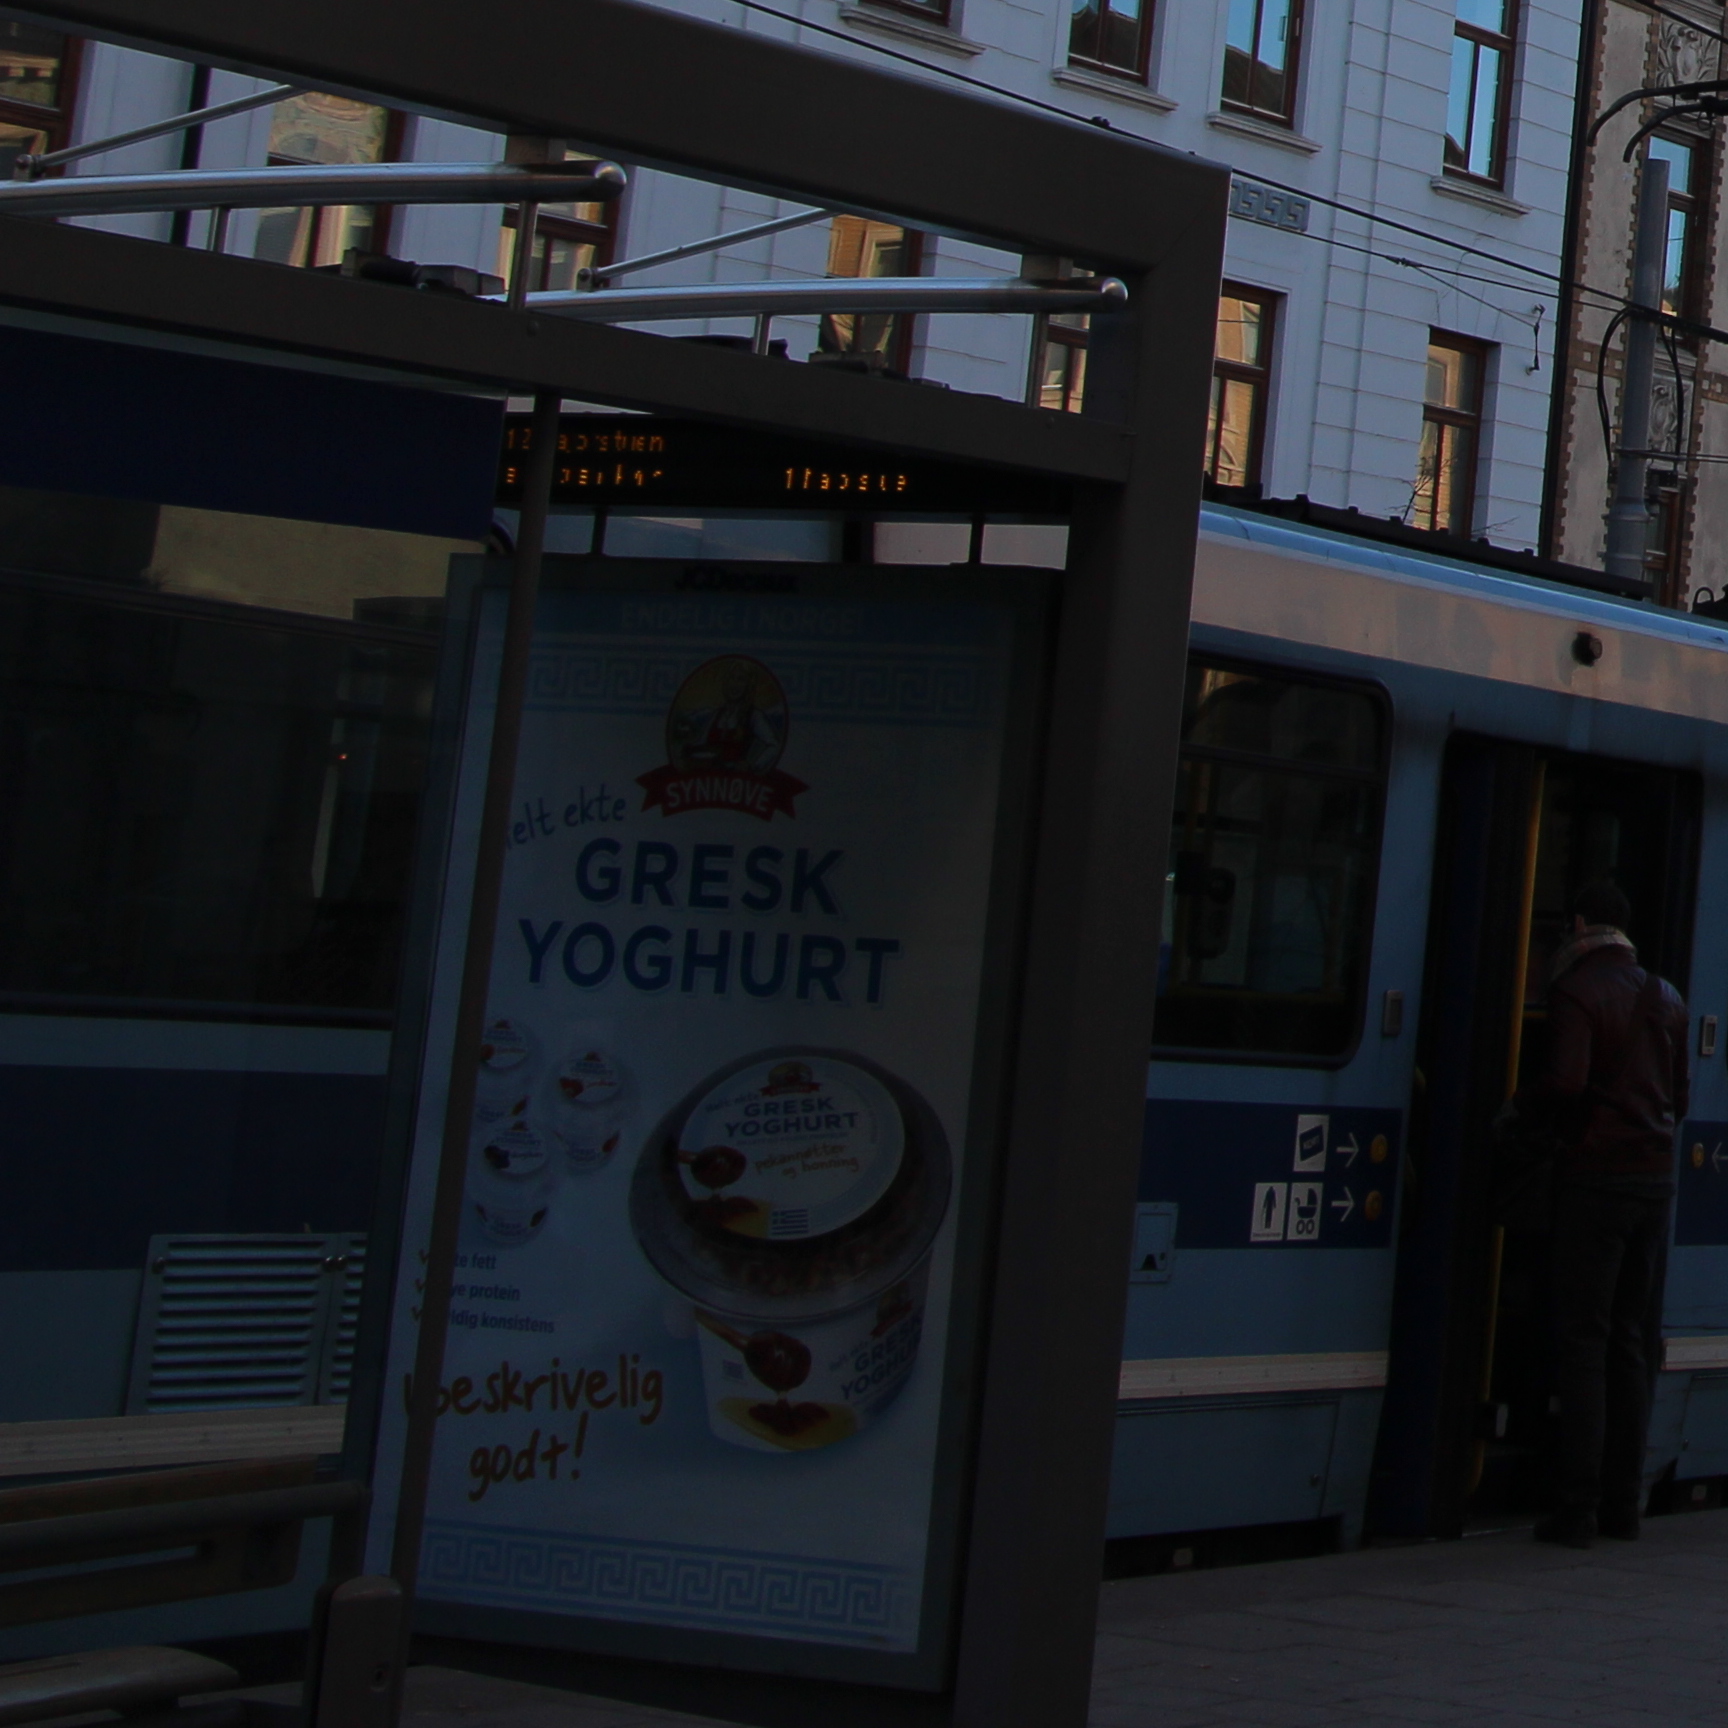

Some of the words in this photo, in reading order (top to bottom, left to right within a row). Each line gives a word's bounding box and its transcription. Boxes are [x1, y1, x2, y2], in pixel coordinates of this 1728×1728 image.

[620, 602, 735, 632] ENDELIG
[742, 603, 750, 631] I
[664, 777, 775, 814] SYNNØVE
[507, 796, 555, 850] elt
[564, 783, 627, 827] ekte
[575, 837, 846, 916] GRESK
[518, 918, 901, 1006] YOGHURT
[743, 1096, 836, 1118] GRESK
[724, 1112, 860, 1139] YOGHURT
[454, 1253, 468, 1268] te
[472, 1252, 497, 1270] fett
[469, 1284, 520, 1301] protein
[450, 1309, 478, 1329] ldig
[480, 1311, 555, 1334] konsistens
[468, 1410, 589, 1502] godt!
